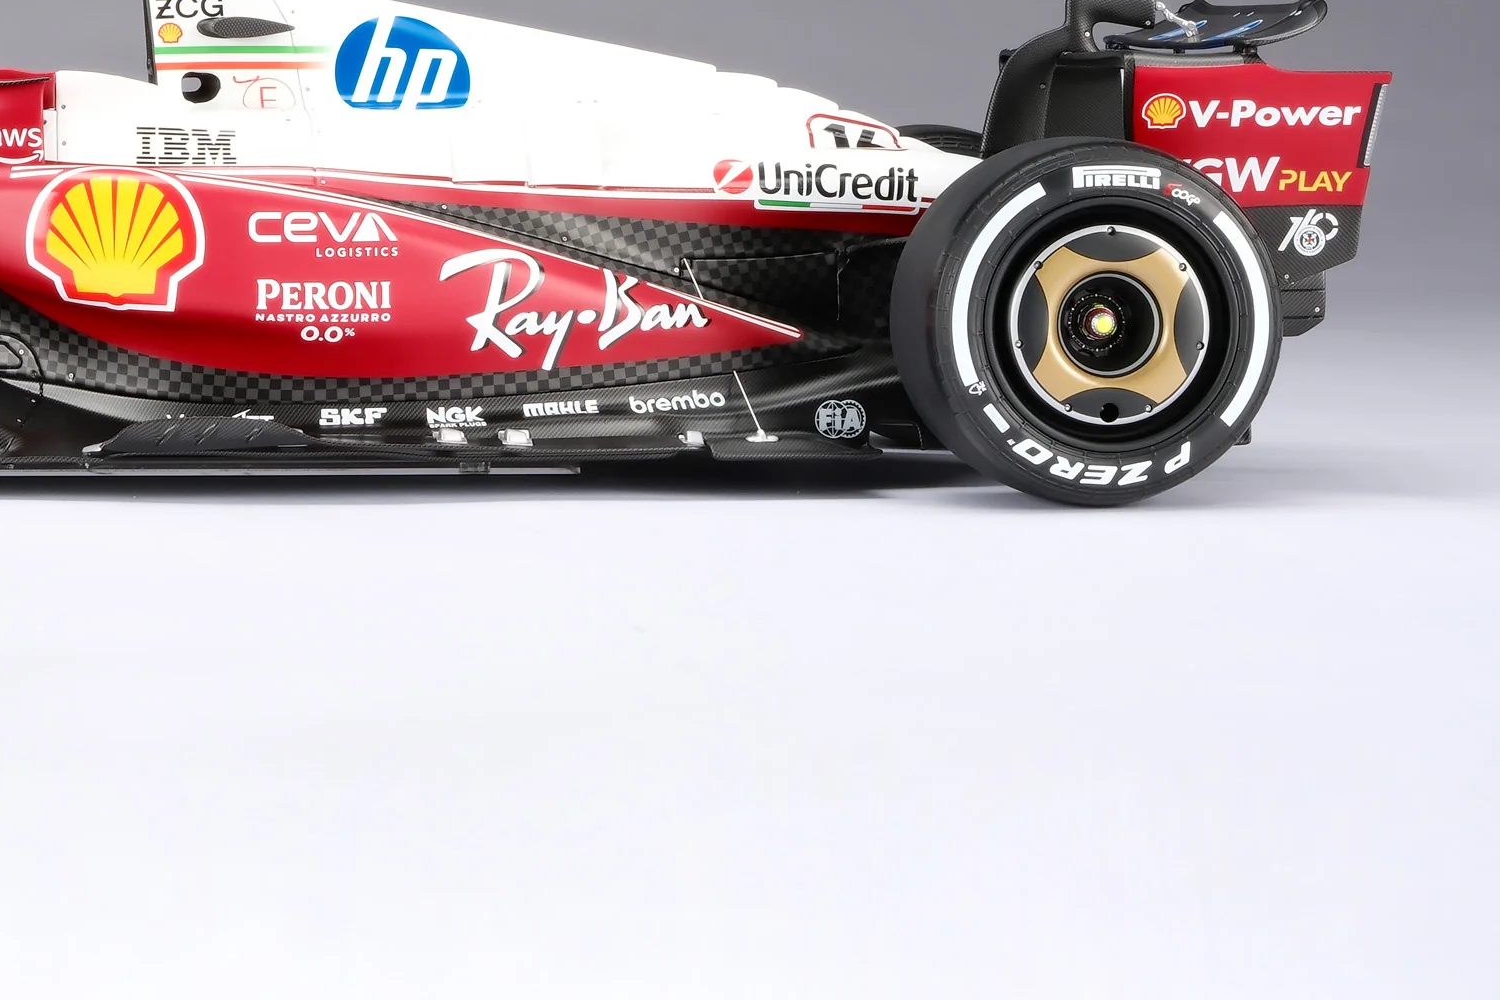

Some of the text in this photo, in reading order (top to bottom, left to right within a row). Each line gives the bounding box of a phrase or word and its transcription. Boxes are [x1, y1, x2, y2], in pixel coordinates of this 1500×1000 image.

[351, 16, 458, 110] hp
[1188, 99, 1362, 128] V-Power
[136, 126, 237, 165] IBM
[758, 161, 919, 203] UniCredit
[1071, 165, 1162, 190] PIRELLI
[1185, 156, 1352, 193] GW PLAY
[316, 247, 399, 258] LOGISTICS
[256, 279, 391, 310] PERONI
[255, 313, 391, 322] NASTRO AZZURRO
[300, 326, 355, 343] 0.0%
[426, 406, 484, 423] NGK
[523, 399, 599, 417] MAHLE
[628, 390, 725, 414] brembo
[319, 407, 387, 426] SKF
[1012, 438, 1191, 486] P ZERO
